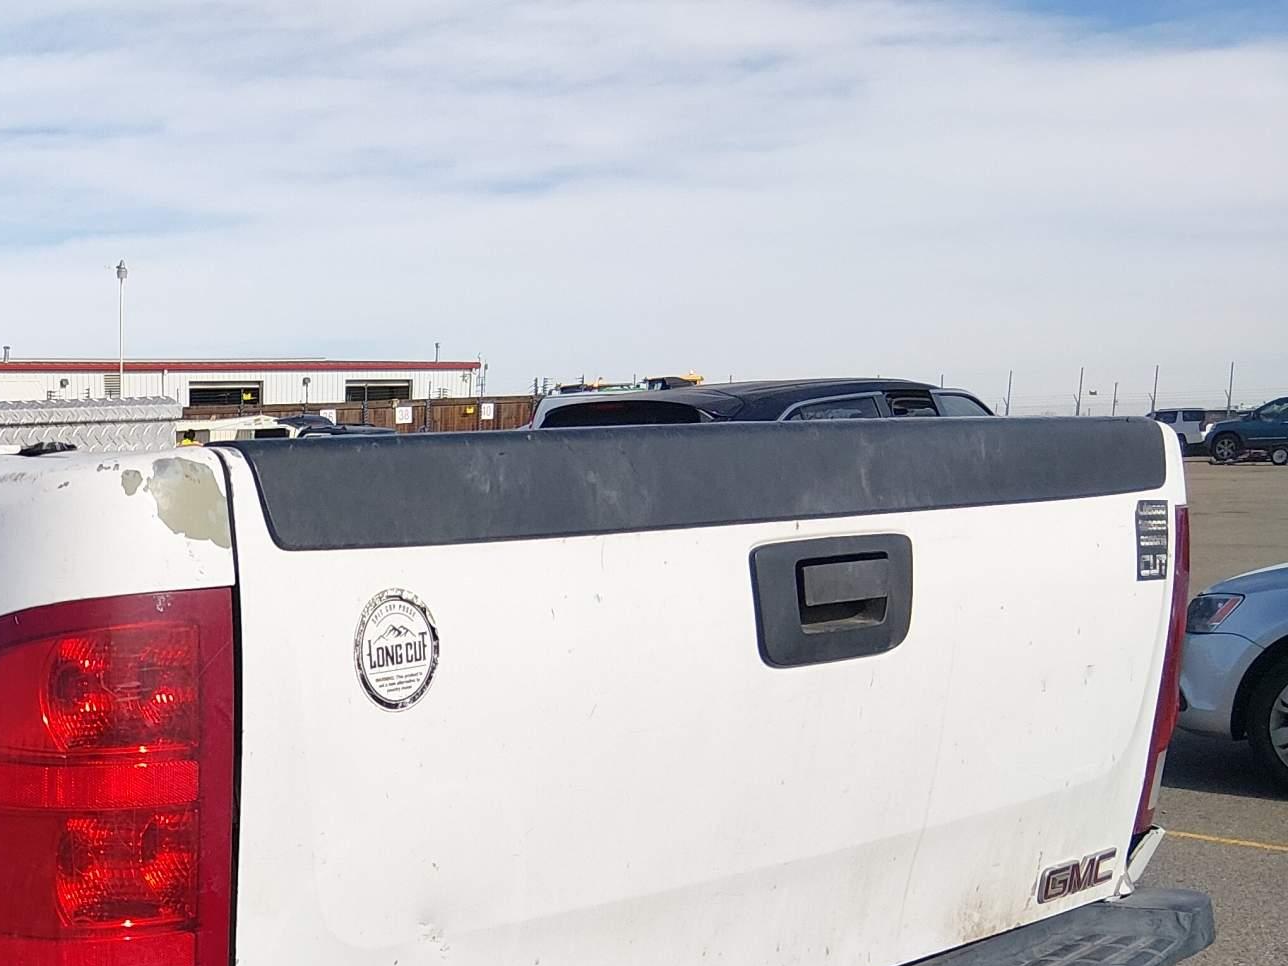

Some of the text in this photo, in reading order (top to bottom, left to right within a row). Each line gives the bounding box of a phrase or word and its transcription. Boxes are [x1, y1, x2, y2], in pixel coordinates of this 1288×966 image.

[366, 631, 427, 669] LONG CUT
[1037, 847, 1117, 904] GMC
